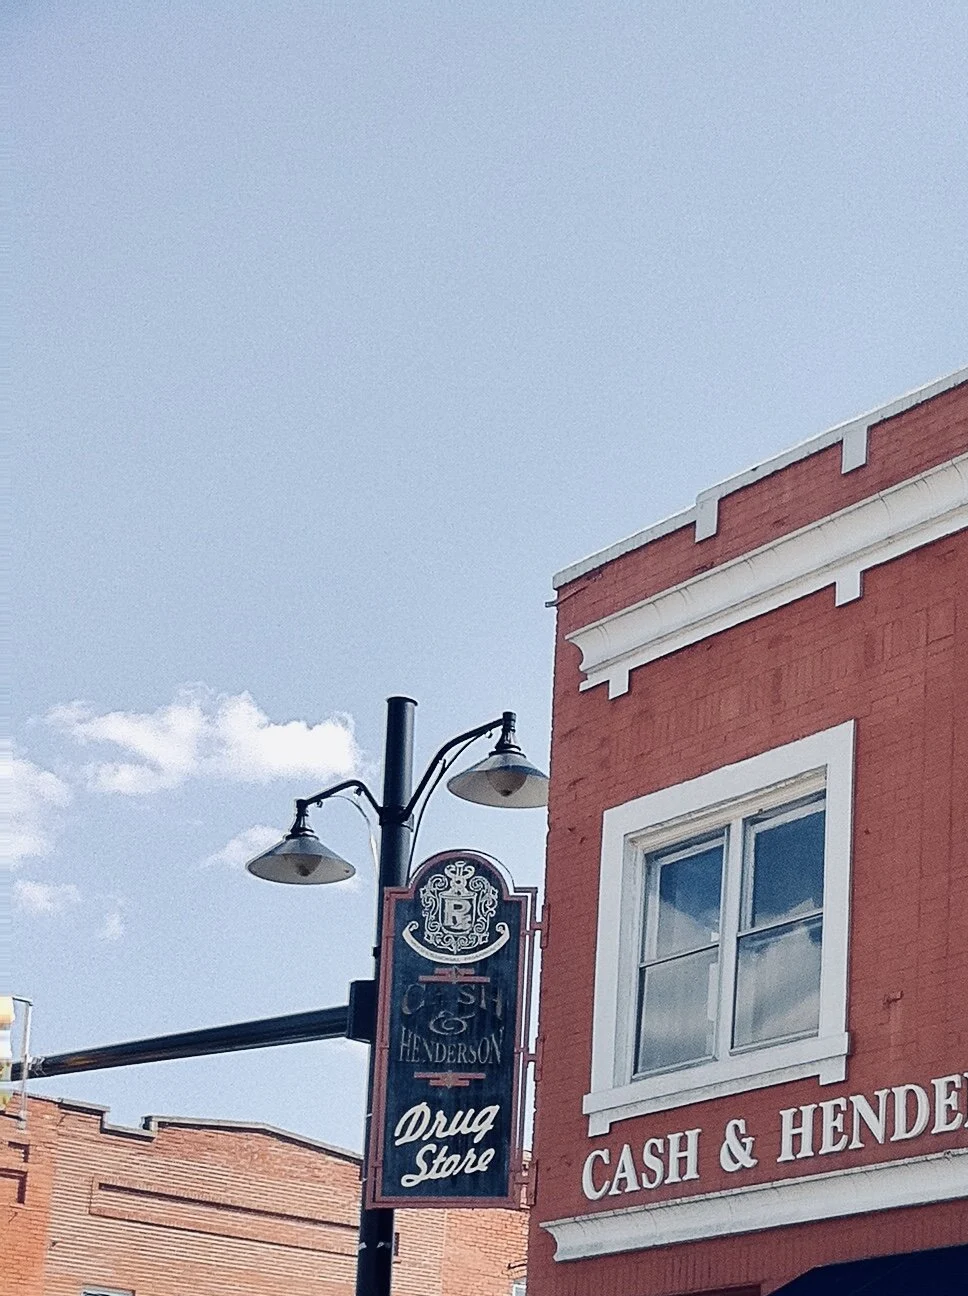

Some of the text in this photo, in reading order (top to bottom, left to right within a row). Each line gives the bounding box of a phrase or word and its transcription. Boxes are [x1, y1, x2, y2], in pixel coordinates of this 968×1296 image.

[401, 983, 503, 1019] CSH
[400, 1026, 504, 1064] HENDERSON
[394, 1101, 500, 1146] Drug
[400, 1143, 496, 1188] Store
[581, 1129, 701, 1200] CASH
[719, 1119, 758, 1173] &
